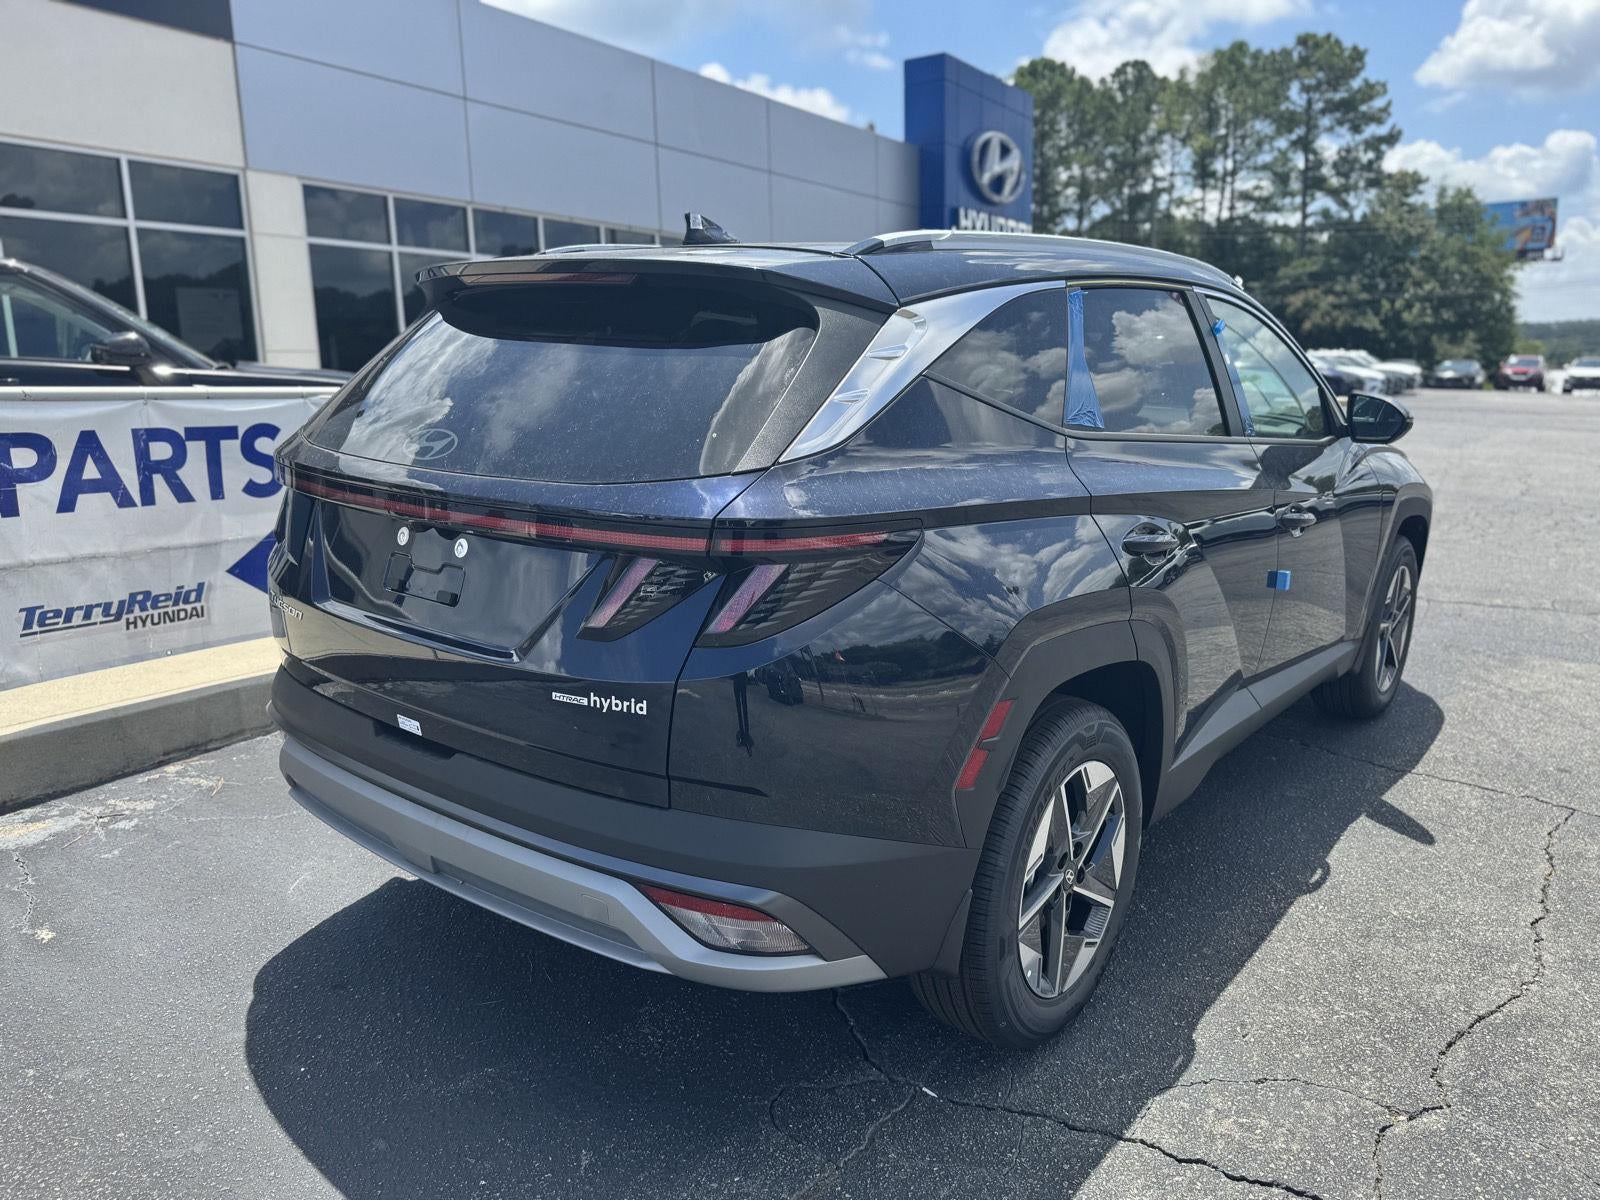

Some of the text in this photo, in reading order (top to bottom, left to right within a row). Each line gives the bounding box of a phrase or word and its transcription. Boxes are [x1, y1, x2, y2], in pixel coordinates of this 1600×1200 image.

[0, 422, 283, 518] PARTS
[125, 605, 205, 631] HYUNDAI
[590, 692, 647, 715] hybrid
